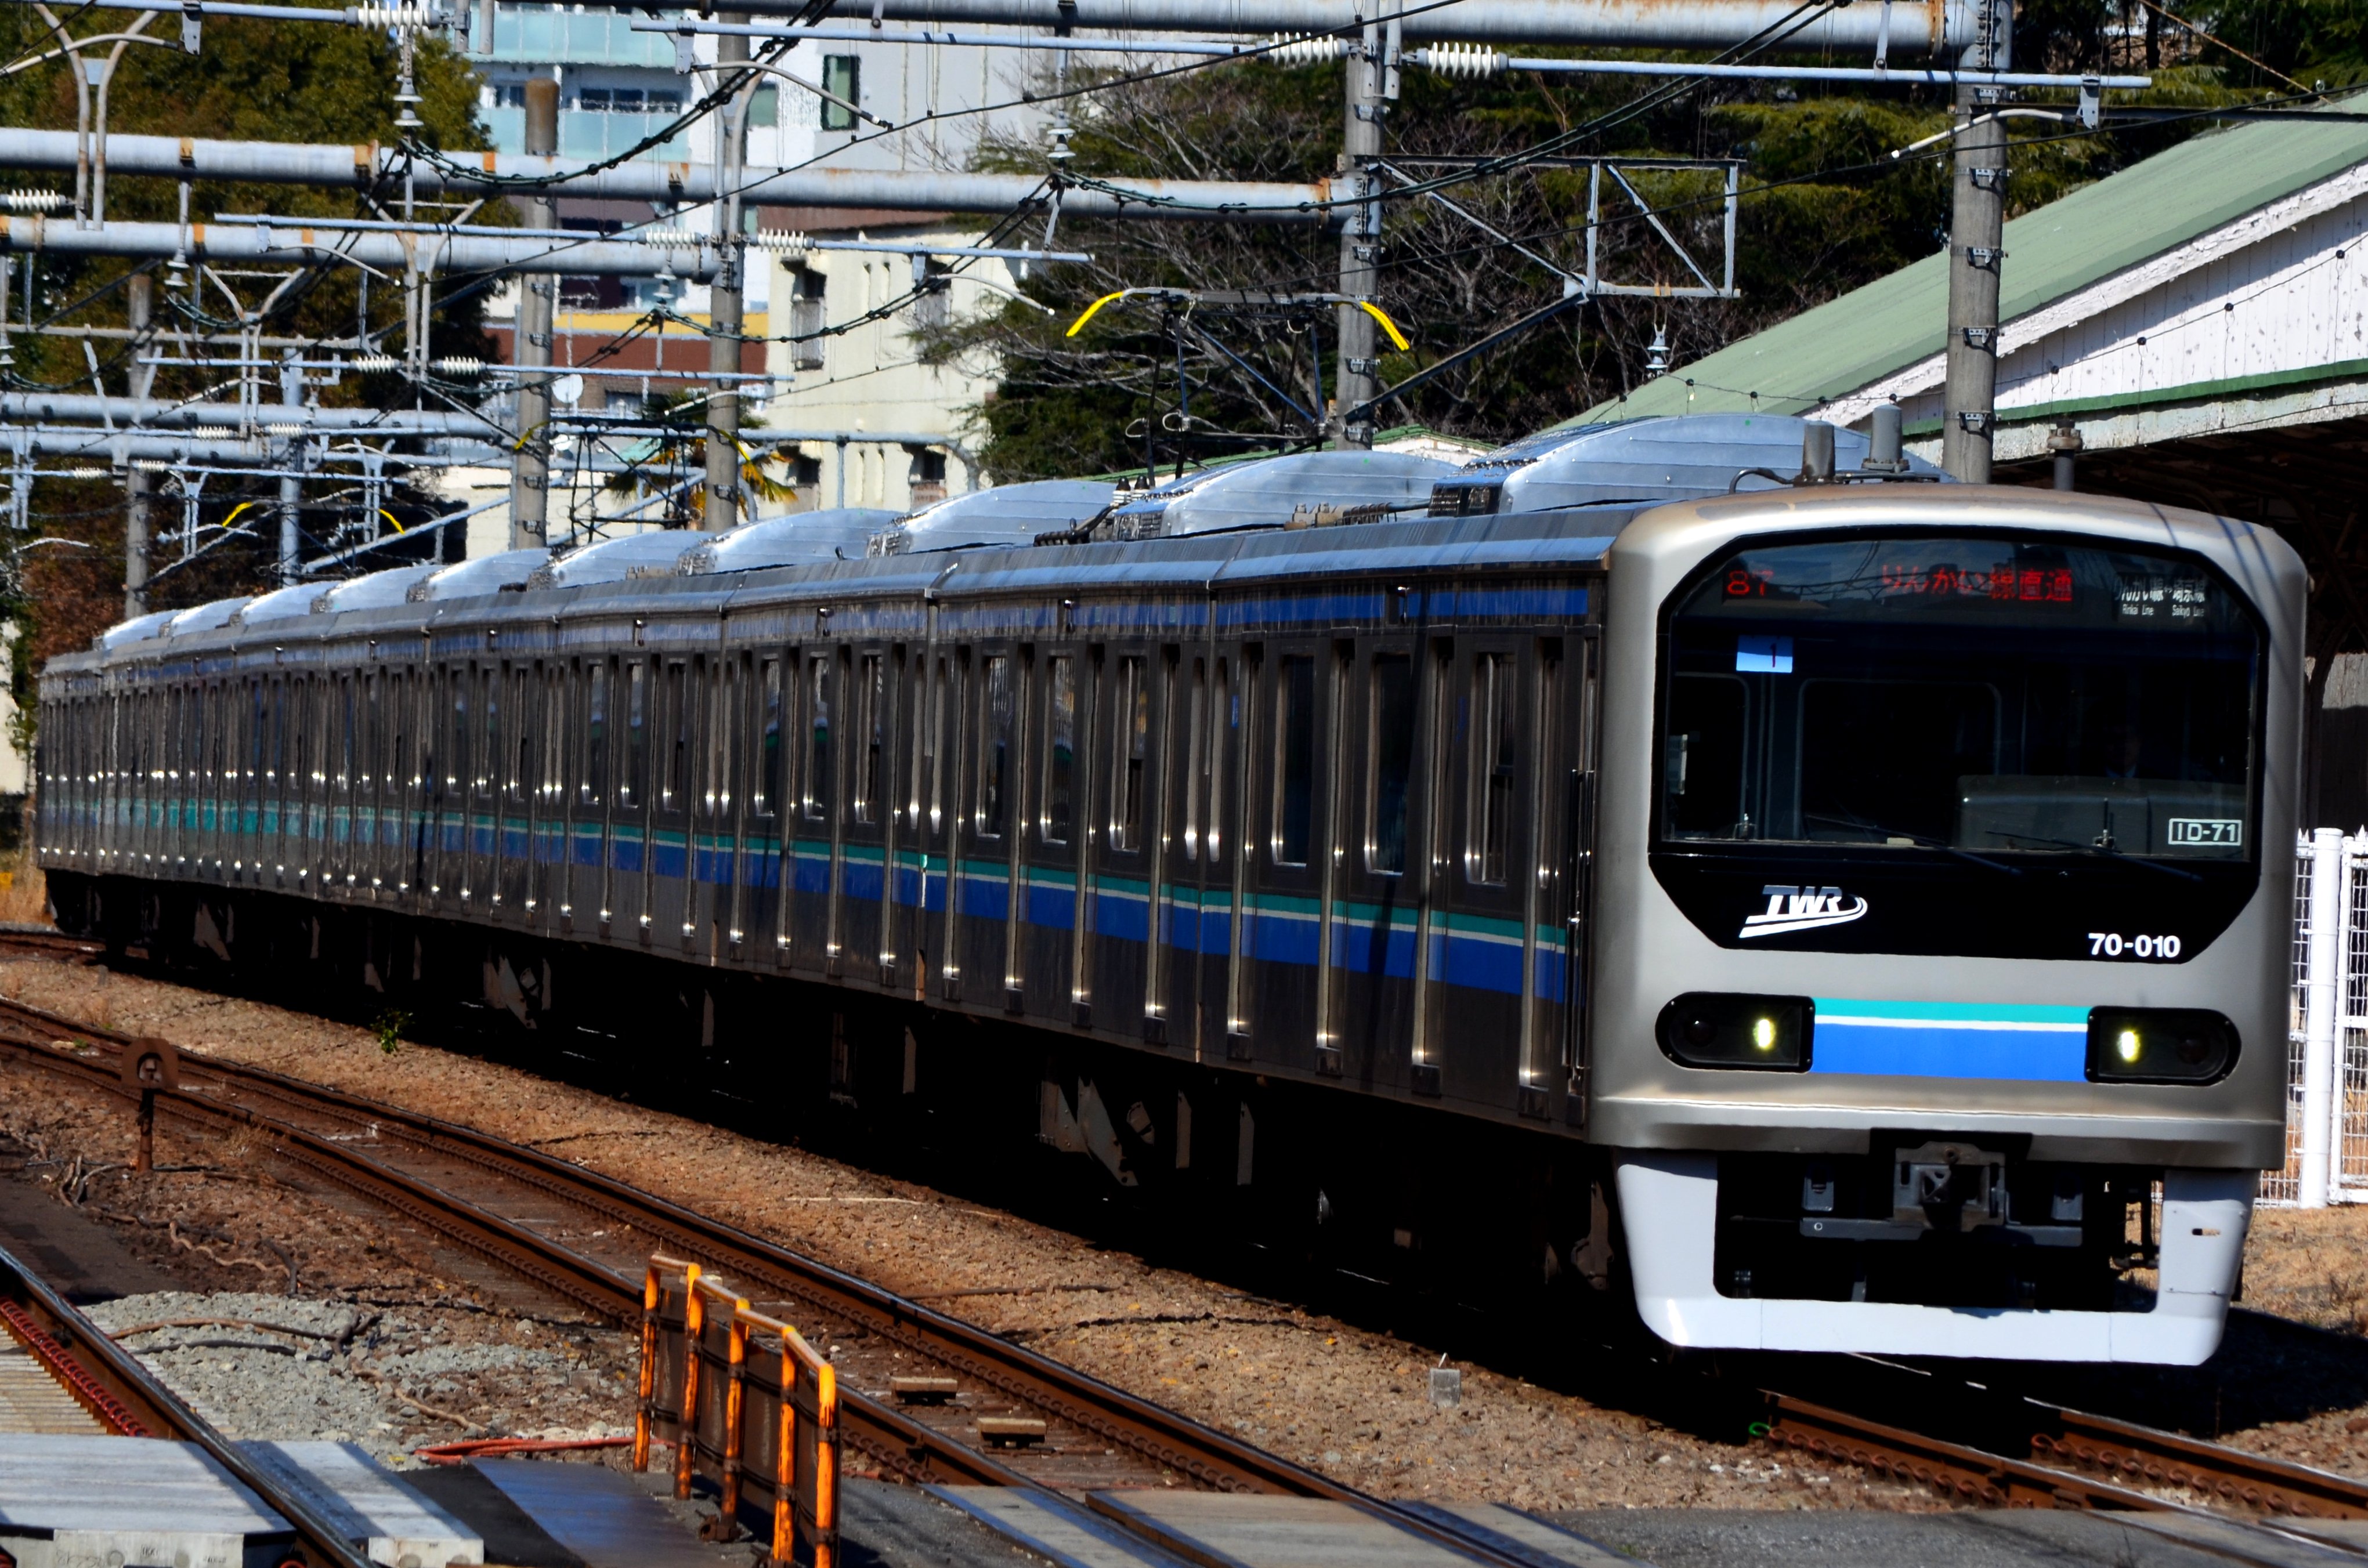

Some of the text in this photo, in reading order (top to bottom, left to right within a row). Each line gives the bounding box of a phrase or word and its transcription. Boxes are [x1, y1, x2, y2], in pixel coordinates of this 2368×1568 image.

[1882, 564, 2073, 602] りんかい線直通
[2142, 604, 2154, 616] Line
[2178, 823, 2236, 842] ID-71
[1762, 885, 1842, 915] TWR
[2088, 932, 2181, 958] 70-010
